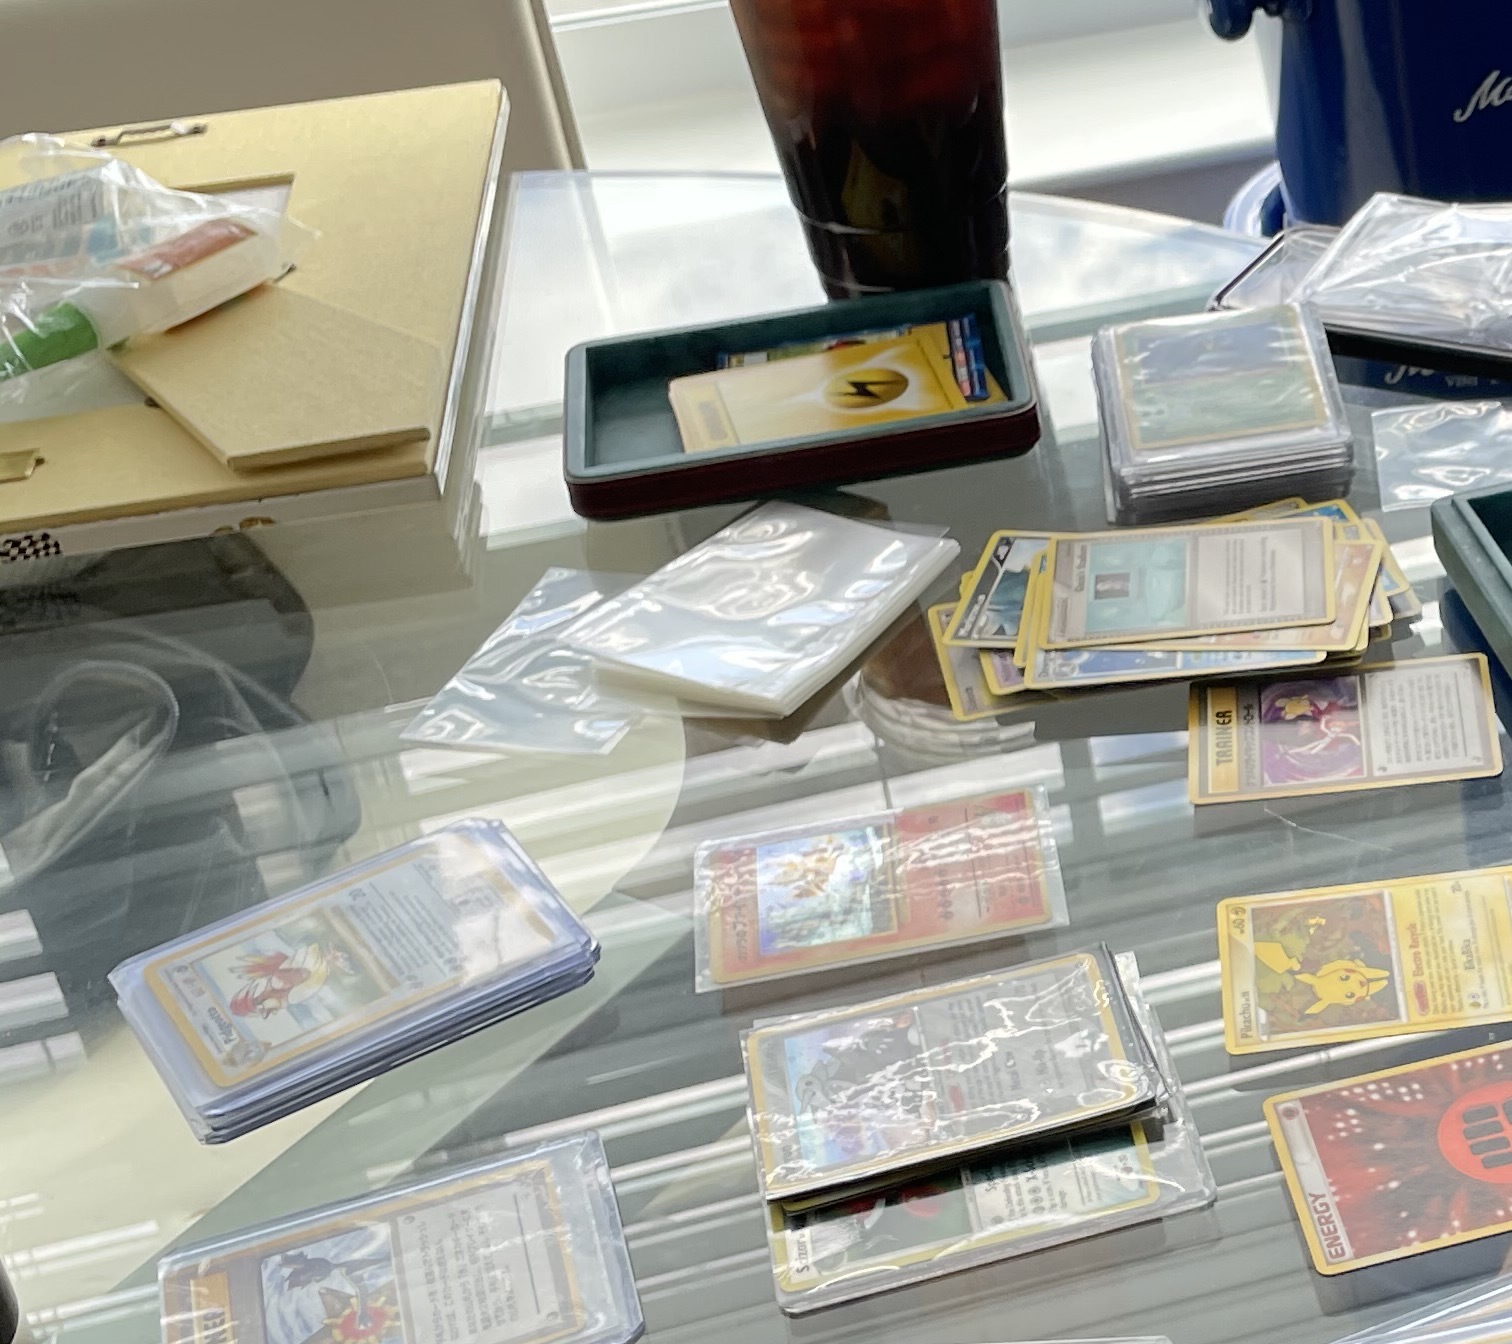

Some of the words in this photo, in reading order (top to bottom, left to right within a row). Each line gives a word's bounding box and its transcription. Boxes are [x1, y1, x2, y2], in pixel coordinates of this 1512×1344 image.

[1213, 709, 1234, 767] TRAINER
[1237, 1001, 1253, 1039] Pikachu
[1306, 1188, 1347, 1261] ENERGY
